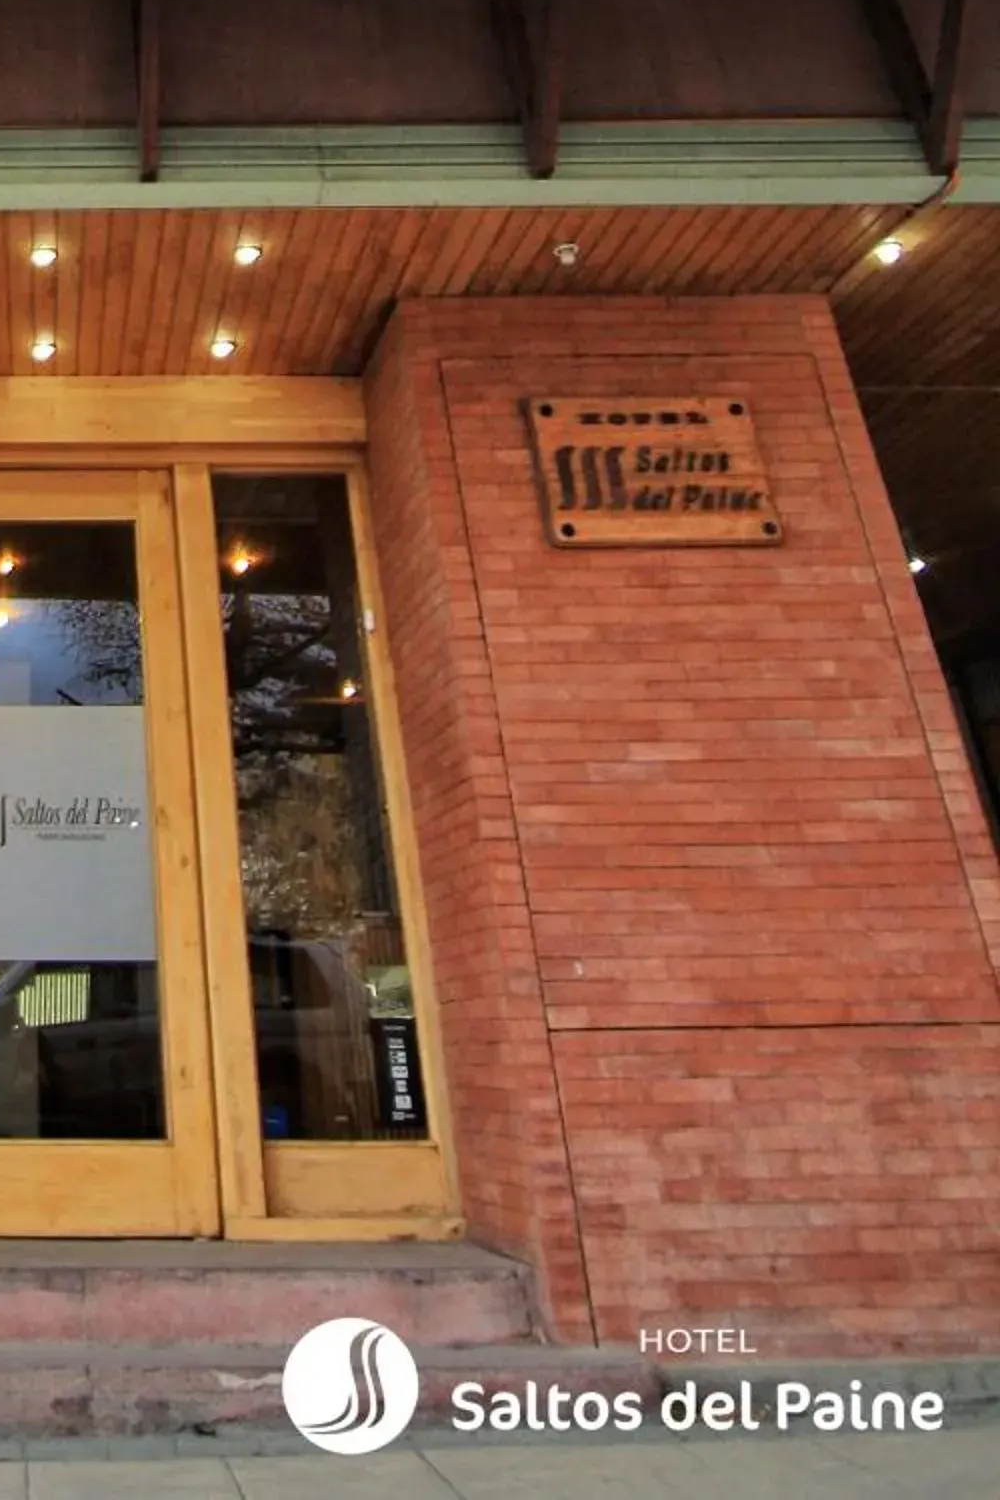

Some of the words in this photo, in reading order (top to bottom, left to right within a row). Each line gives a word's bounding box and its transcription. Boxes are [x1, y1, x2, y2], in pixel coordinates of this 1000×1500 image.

[635, 447, 730, 473] Saltos
[632, 486, 675, 511] del
[12, 796, 60, 826] Saltos
[65, 796, 88, 826] del
